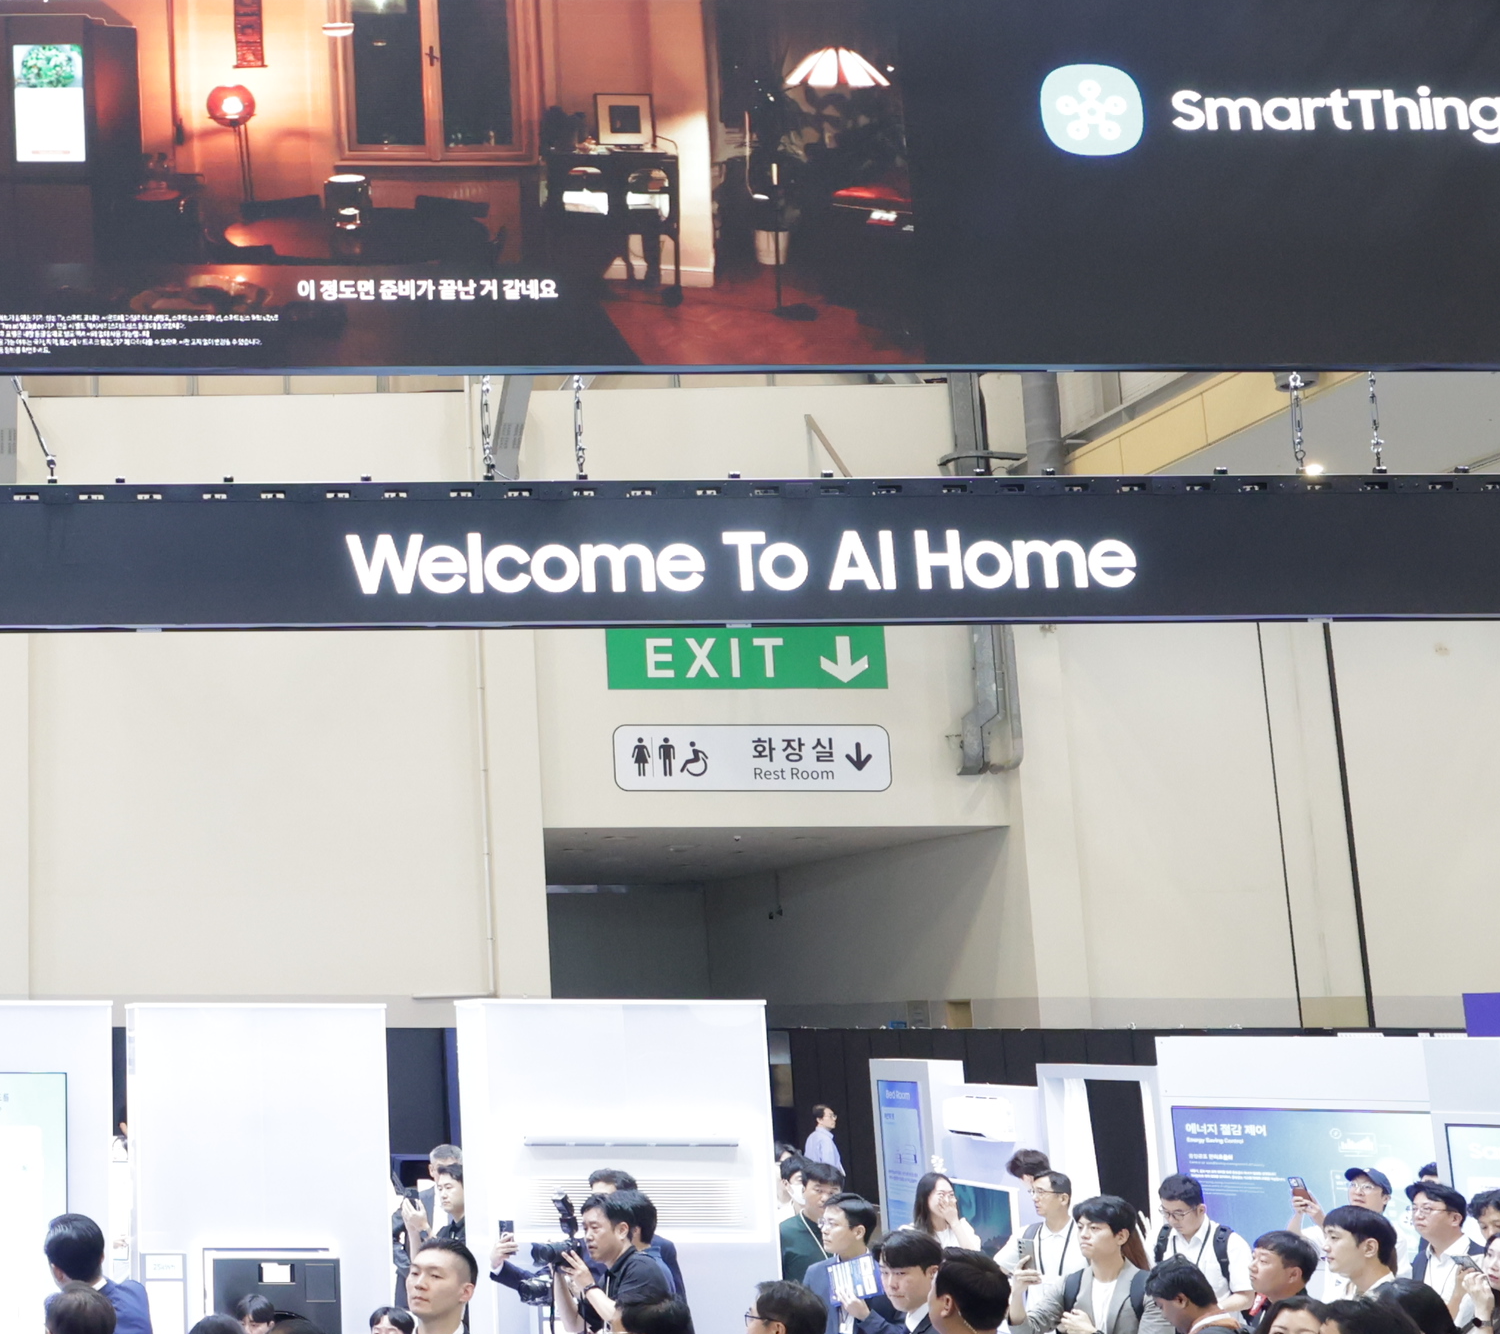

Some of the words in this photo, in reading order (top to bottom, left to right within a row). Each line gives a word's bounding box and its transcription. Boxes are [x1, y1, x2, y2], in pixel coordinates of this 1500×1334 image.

[297, 279, 315, 300] 이
[319, 279, 375, 300] 정도면
[379, 279, 435, 300] 준비가
[438, 279, 476, 300] 끝난
[480, 279, 498, 300] 거
[502, 279, 558, 300] 같네요
[346, 533, 706, 595] Welcome
[722, 531, 808, 592] To
[829, 529, 897, 591] AI
[915, 529, 1138, 590] Home
[645, 637, 784, 678] EXIT
[751, 737, 835, 763] 화장실
[753, 768, 786, 780] Rest
[790, 768, 835, 780] Room
[885, 1089, 896, 1100] Bed
[896, 1091, 911, 1101] Room
[1185, 1123, 1218, 1135] 에너지
[1220, 1123, 1242, 1136] 절감
[1244, 1124, 1267, 1137] 제어
[1186, 1137, 1205, 1145] Energy
[1205, 1137, 1223, 1145] Saving
